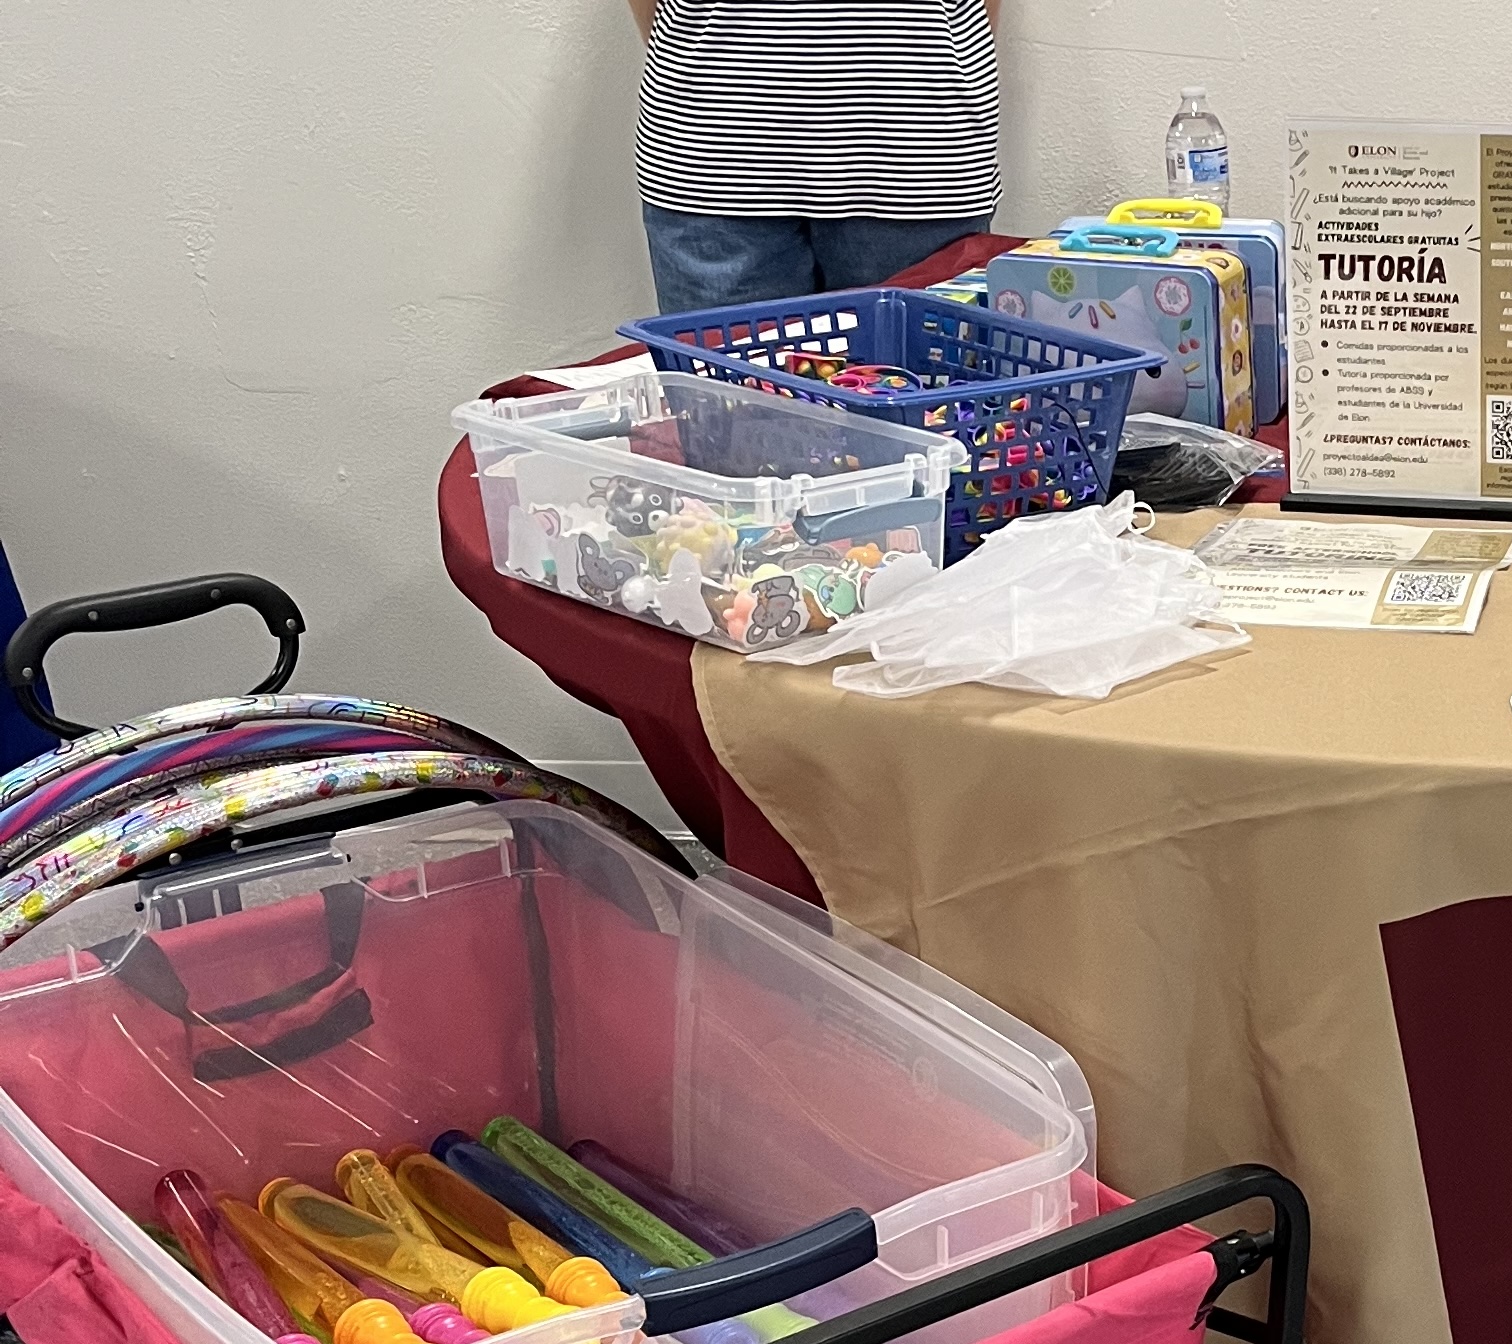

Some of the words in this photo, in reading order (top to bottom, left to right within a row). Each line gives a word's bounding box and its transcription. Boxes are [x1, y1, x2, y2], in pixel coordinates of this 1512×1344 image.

[1362, 146, 1397, 156] ELON
[1313, 194, 1338, 204] ¿Está
[1342, 194, 1387, 204] buscando
[1392, 196, 1420, 207] apoyo
[1424, 197, 1475, 207] académico
[1339, 207, 1379, 216] adicional
[1383, 209, 1402, 218] para
[1421, 209, 1442, 219] hijo?
[1317, 221, 1379, 231] ACTIVIDADES
[1317, 234, 1404, 244] EXTRAESCOLARES
[1408, 236, 1459, 246] GRATUITAS
[1318, 248, 1446, 284] TUTORÍA
[1320, 290, 1328, 300] A
[1332, 290, 1371, 301] PARTIR
[1376, 292, 1390, 302] DE
[1394, 292, 1408, 302] LA
[1413, 293, 1459, 304] SEMANA
[1320, 304, 1340, 315] DEL
[1344, 306, 1357, 315] 22
[1362, 306, 1376, 316] DE
[1381, 307, 1449, 318] SEPTIEMBRE
[1320, 319, 1356, 330] HASTA
[1361, 320, 1374, 330] EL
[1379, 321, 1388, 331] 17
[1392, 321, 1406, 331] DE
[1411, 322, 1477, 334] NOVIEMBRE.
[1337, 341, 1373, 351] Comidas
[1377, 344, 1443, 354] proporcionadas
[1456, 346, 1468, 354] los
[1337, 357, 1385, 365] estudiantes
[1337, 369, 1367, 379] Tutoría
[1371, 371, 1431, 381] proporcionada
[1435, 374, 1449, 382] por
[1337, 385, 1382, 394] profesores
[1385, 385, 1396, 394] de
[1428, 388, 1433, 396] y
[1338, 399, 1386, 408] estudiantes
[1389, 401, 1399, 409] de
[1403, 401, 1410, 409] la
[1414, 401, 1463, 411] Universidad
[1324, 434, 1392, 445] ¿PREGUNTAS?
[1397, 435, 1471, 448] CONTÁCTANOS:
[1249, 548, 1397, 561] TUTORING
[1218, 585, 1279, 593] ESTIONS?
[1284, 587, 1345, 596] CONTACT
